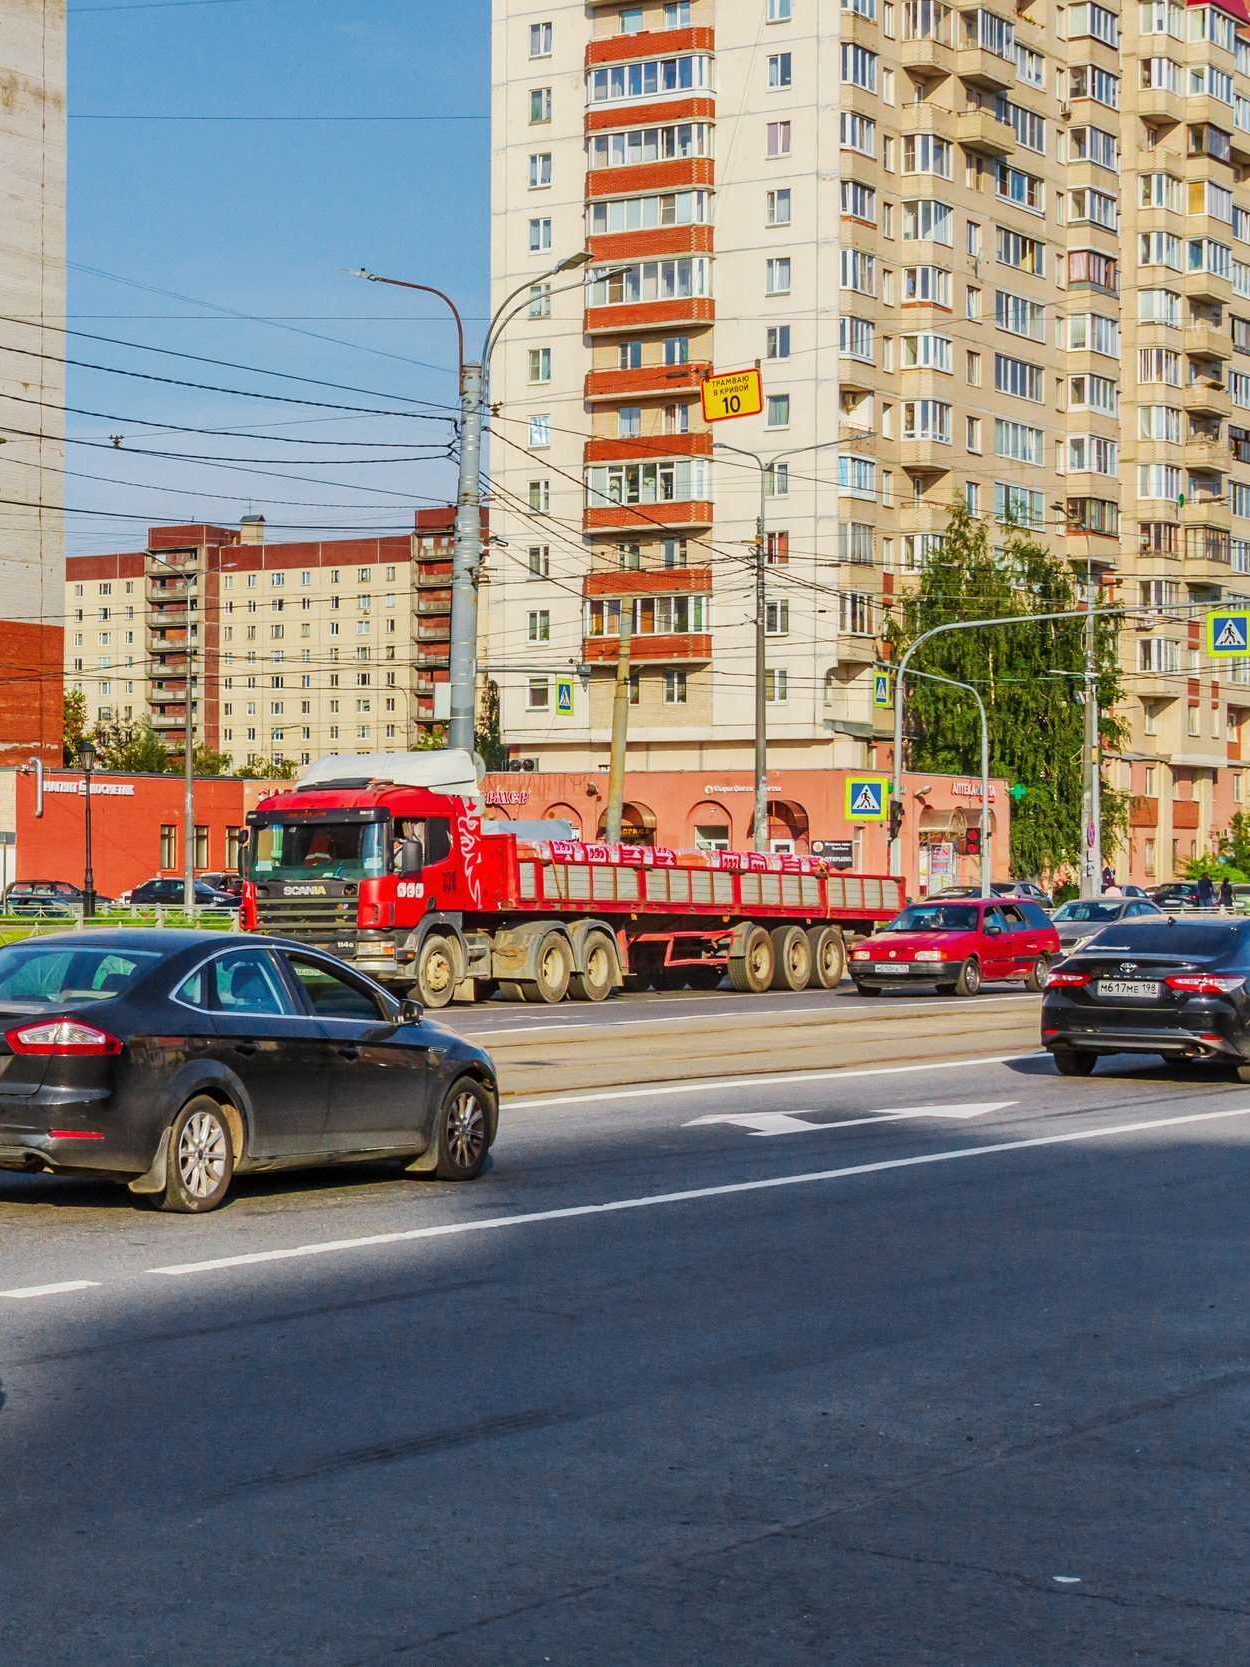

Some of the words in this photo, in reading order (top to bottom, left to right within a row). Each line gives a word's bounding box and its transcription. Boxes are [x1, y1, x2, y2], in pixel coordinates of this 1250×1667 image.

[712, 375, 749, 387] ТРАМВАЮ
[720, 383, 749, 395] КРИВОЙ
[722, 395, 741, 414] 10
[952, 783, 976, 795] АПТЕКА
[283, 886, 326, 895] SCANIA
